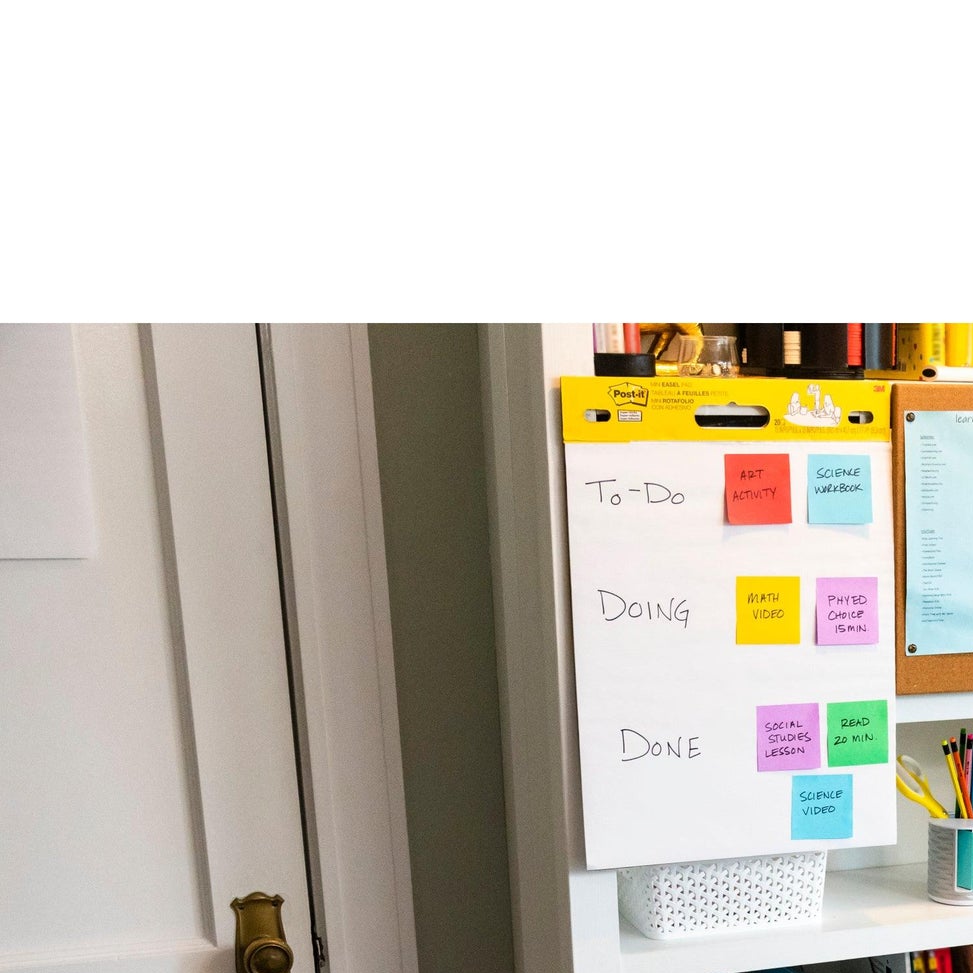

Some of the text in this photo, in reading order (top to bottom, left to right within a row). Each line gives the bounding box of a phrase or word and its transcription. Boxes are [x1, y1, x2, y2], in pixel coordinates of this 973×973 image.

[613, 389, 645, 398] Post-it
[740, 469, 764, 480] ART
[816, 467, 861, 479] SCIENCE
[733, 487, 777, 502] ACTIVITY
[814, 483, 863, 494] WORKBOOK
[747, 592, 779, 604] MATH
[597, 589, 690, 629] DOING
[752, 609, 785, 620] VIDEO
[765, 721, 803, 733] SOCIAL
[841, 717, 870, 729] READ
[768, 732, 812, 744] STUDIES
[833, 736, 848, 746] 20
[765, 746, 805, 758] LESSON
[799, 789, 844, 802] SCIENCE
[802, 805, 836, 816] VIDEO
